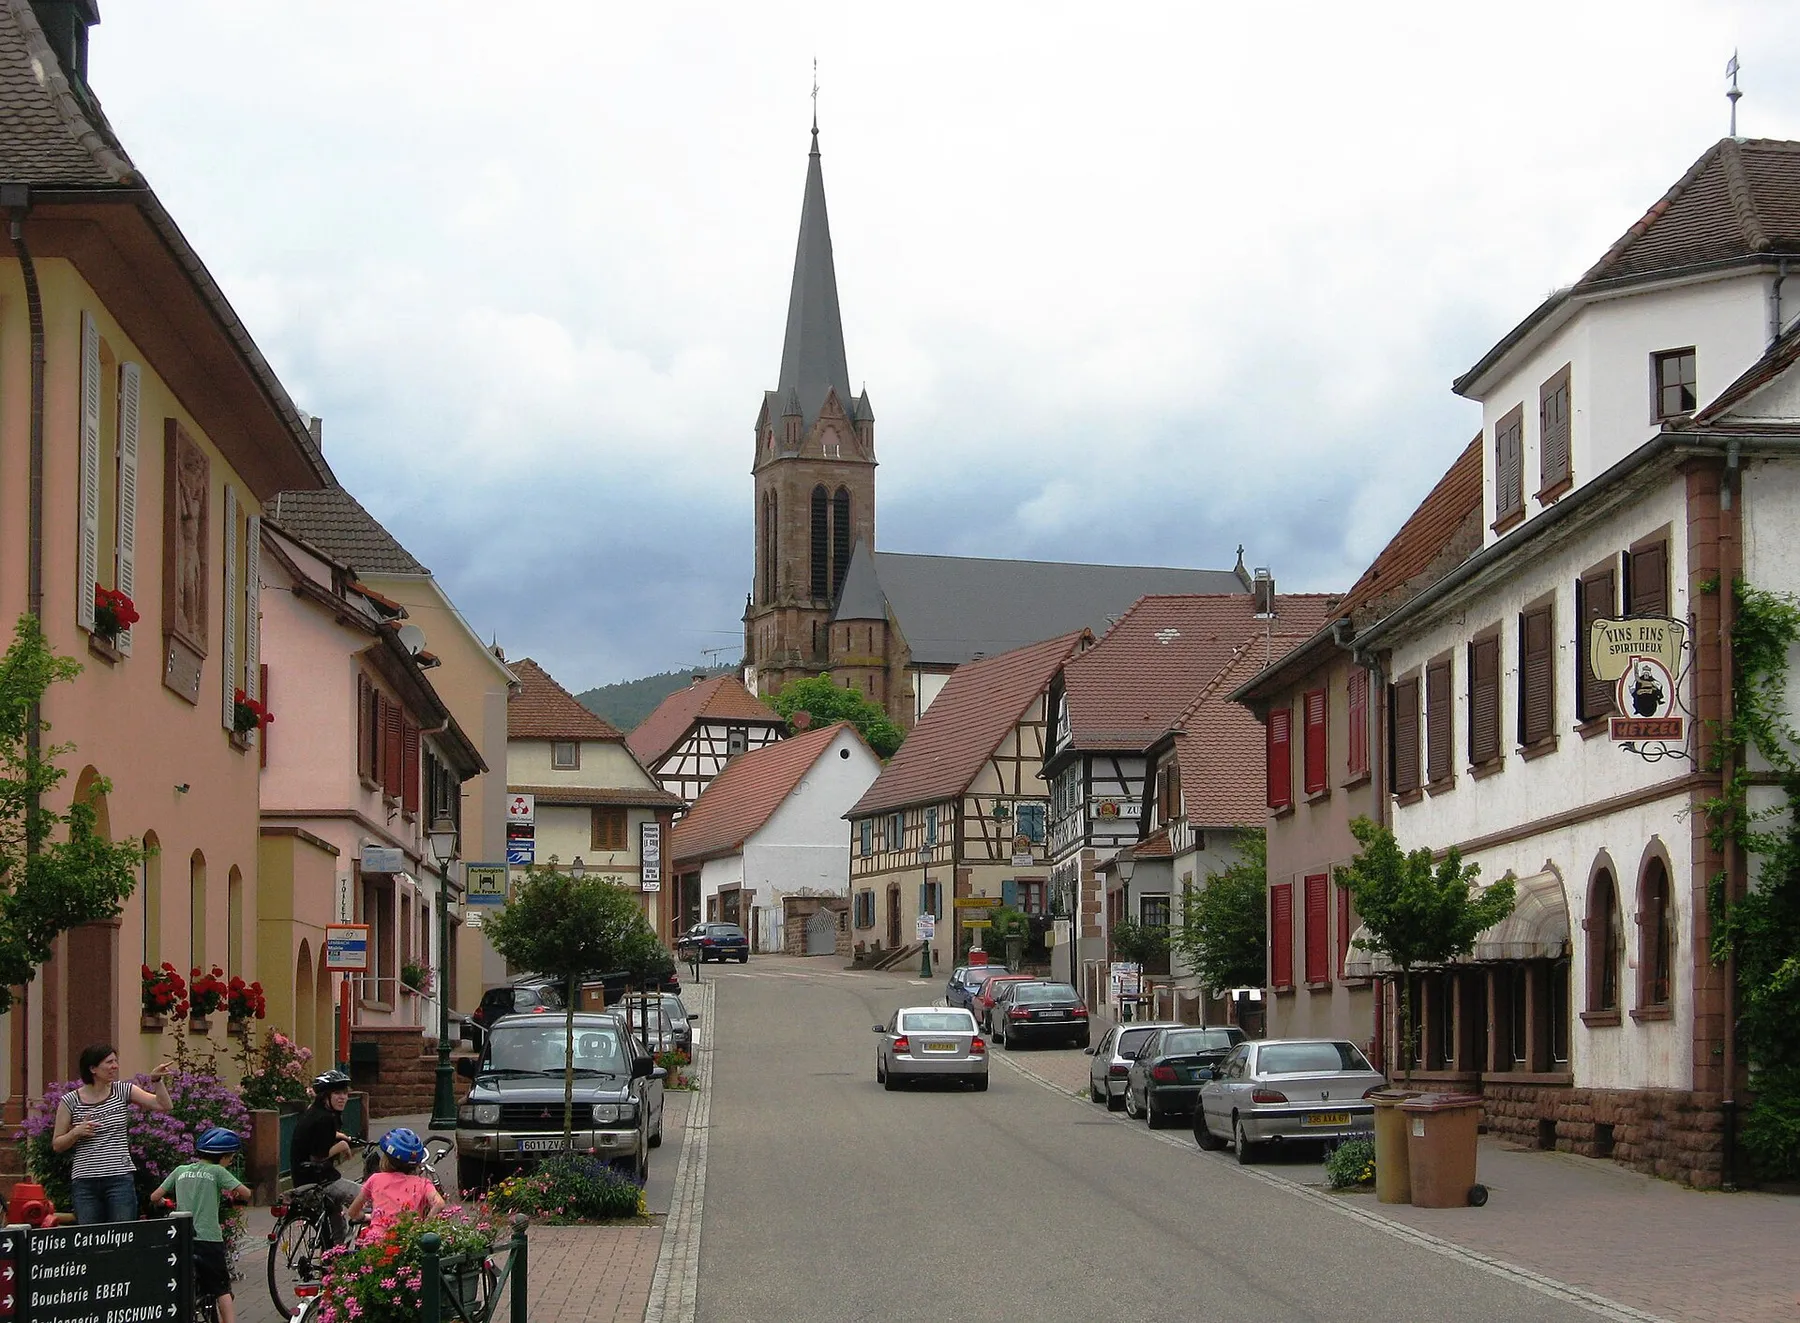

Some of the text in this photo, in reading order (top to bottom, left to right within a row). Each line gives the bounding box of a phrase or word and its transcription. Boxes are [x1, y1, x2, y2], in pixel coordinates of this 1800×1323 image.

[1606, 627, 1664, 642] VINS FINS
[1609, 642, 1662, 655] SPIRITUEUX
[1127, 806, 1143, 815] ZU
[524, 1141, 546, 1149] 6011
[31, 1236, 66, 1254] Eglise
[31, 1262, 87, 1280] Cimetière
[31, 1281, 131, 1307] Boucherie EBERT
[107, 1304, 163, 1323] BISCHUNG
